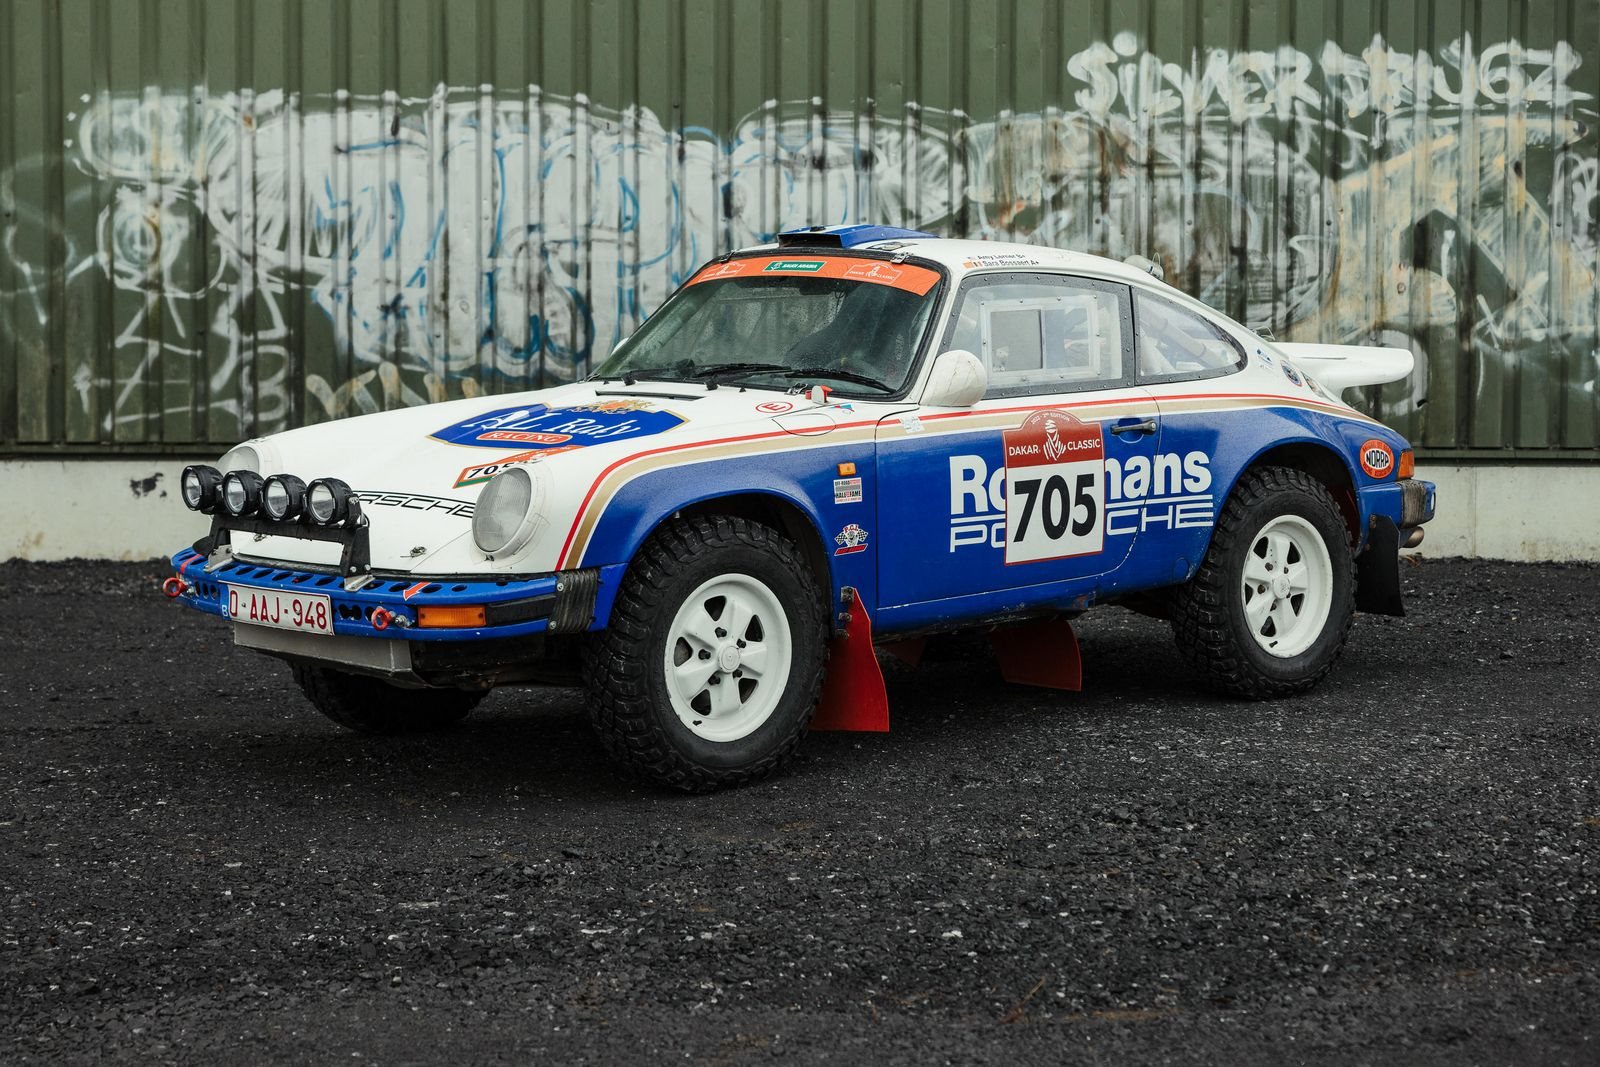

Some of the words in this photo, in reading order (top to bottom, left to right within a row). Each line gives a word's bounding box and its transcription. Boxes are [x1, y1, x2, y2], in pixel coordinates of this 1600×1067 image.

[489, 432, 560, 443] RACING
[1008, 444, 1039, 456] DAKAR
[1067, 438, 1101, 451] CLASSIC
[1012, 473, 1098, 544] 705
[221, 604, 229, 617] B
